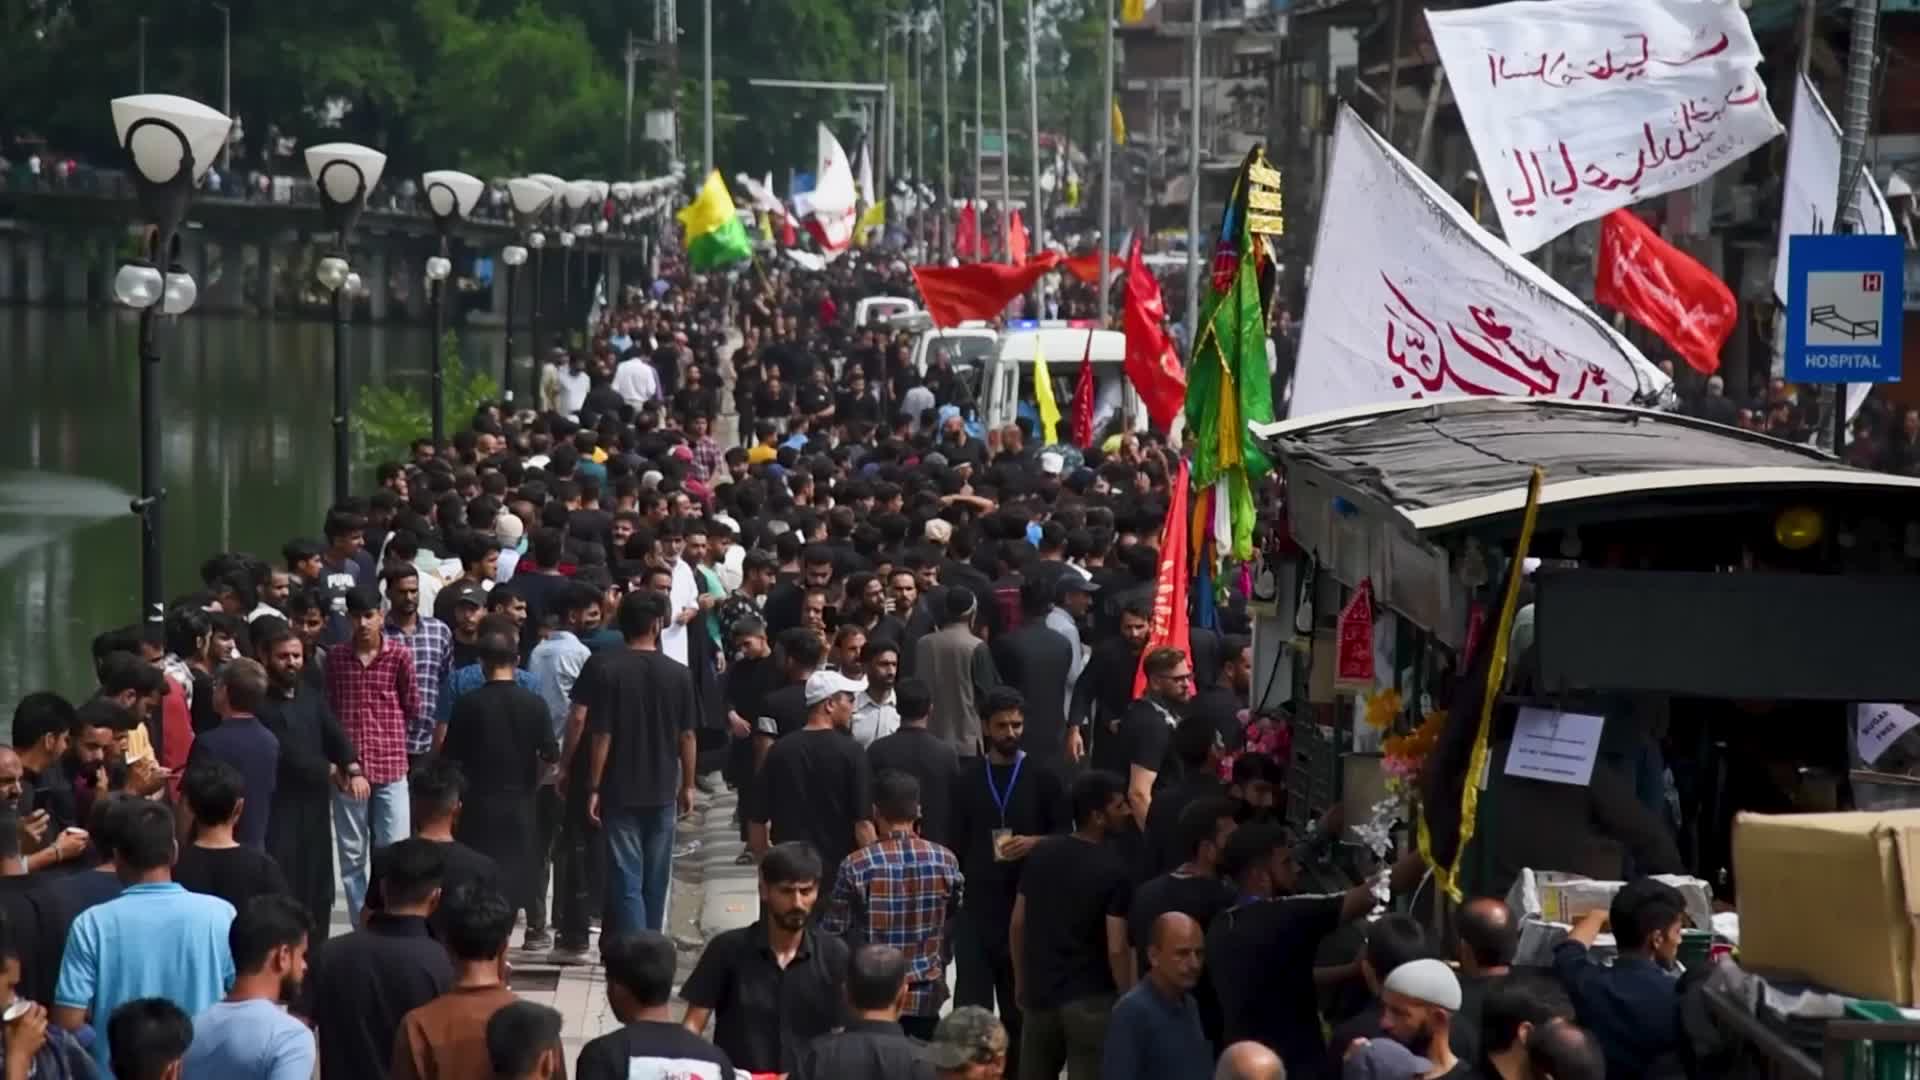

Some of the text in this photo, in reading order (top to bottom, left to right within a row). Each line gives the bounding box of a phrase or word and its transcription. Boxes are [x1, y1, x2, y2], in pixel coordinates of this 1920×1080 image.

[1864, 275, 1879, 291] H
[1805, 354, 1882, 369] HOSPITAL
[327, 573, 355, 588] PUMA
